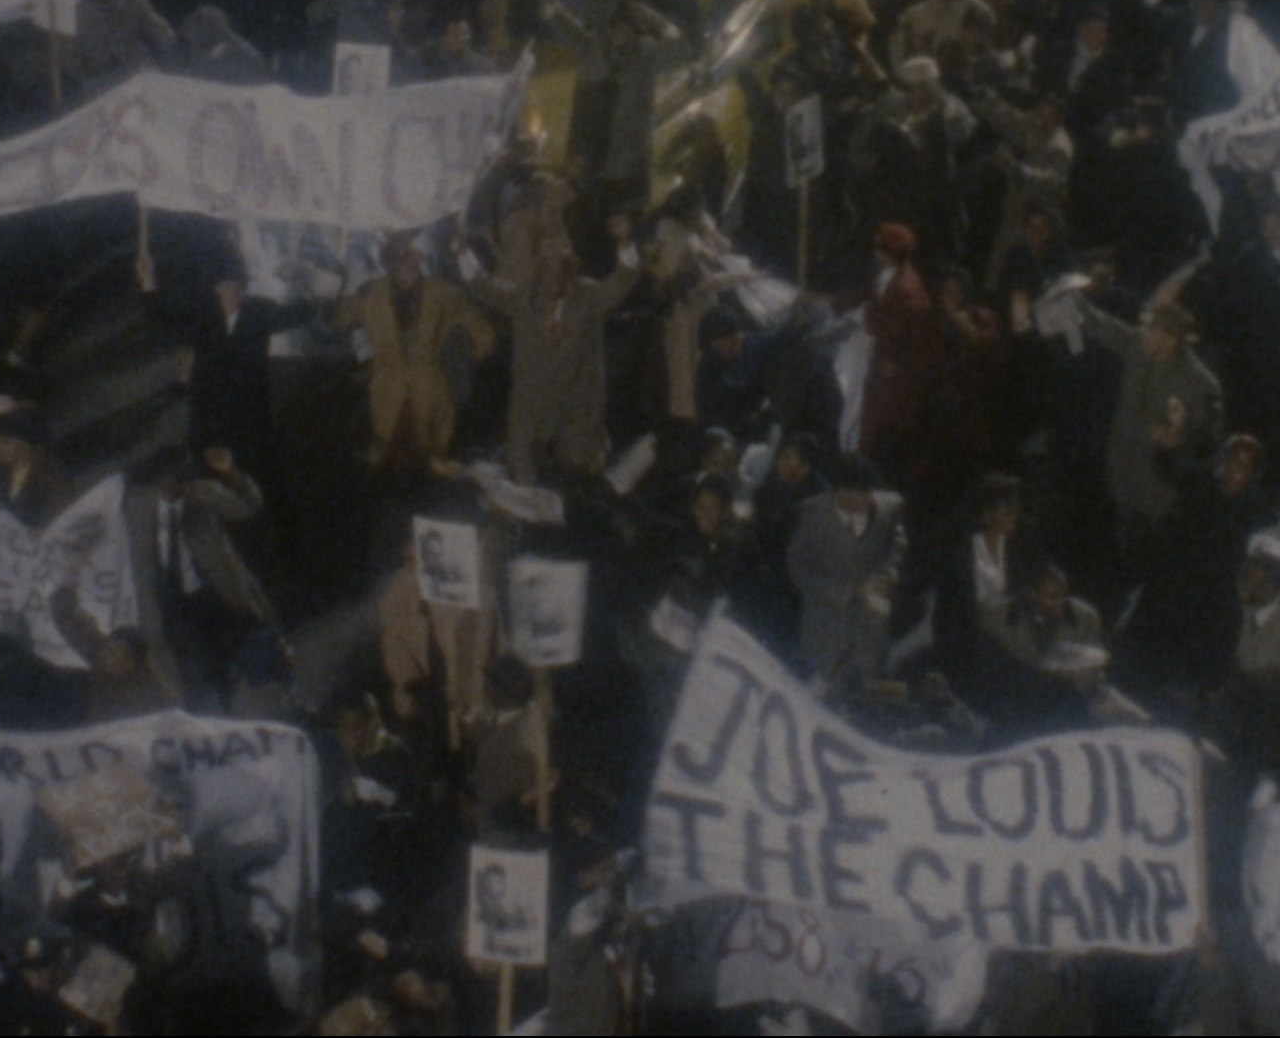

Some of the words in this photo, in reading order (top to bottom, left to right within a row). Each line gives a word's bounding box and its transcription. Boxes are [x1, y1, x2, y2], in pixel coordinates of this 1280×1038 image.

[670, 652, 890, 829] JOE
[911, 740, 1191, 847] LOUIS
[653, 791, 871, 913] THE
[895, 846, 1190, 947] CHAMP
